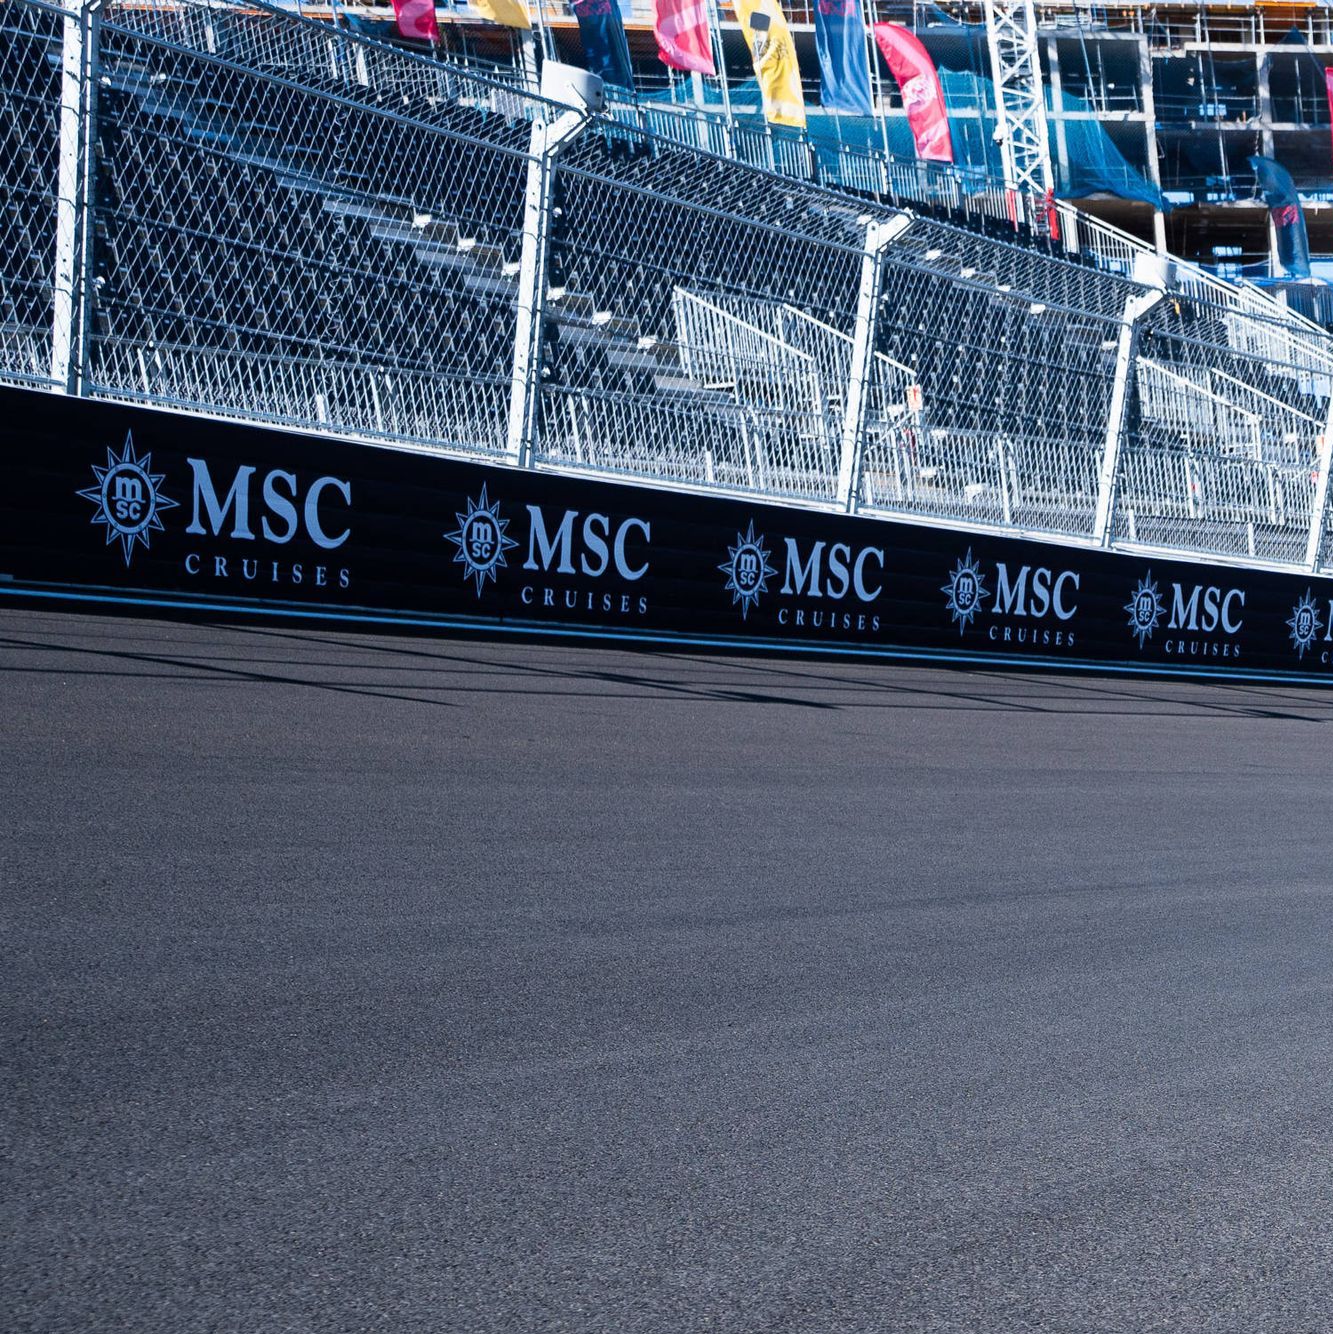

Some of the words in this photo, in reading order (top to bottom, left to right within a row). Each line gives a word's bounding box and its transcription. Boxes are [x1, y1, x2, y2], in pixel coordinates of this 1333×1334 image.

[186, 458, 351, 548] MSC
[523, 505, 650, 580] MSC
[185, 554, 349, 587] CRUISES
[780, 538, 884, 601] MSC
[521, 587, 646, 613] CRUISES
[994, 563, 1079, 620] MSC
[1168, 583, 1245, 633] MSC
[778, 609, 879, 630] CRUISES
[989, 626, 1074, 646] CRUISES
[1165, 640, 1239, 656] CRUISES
